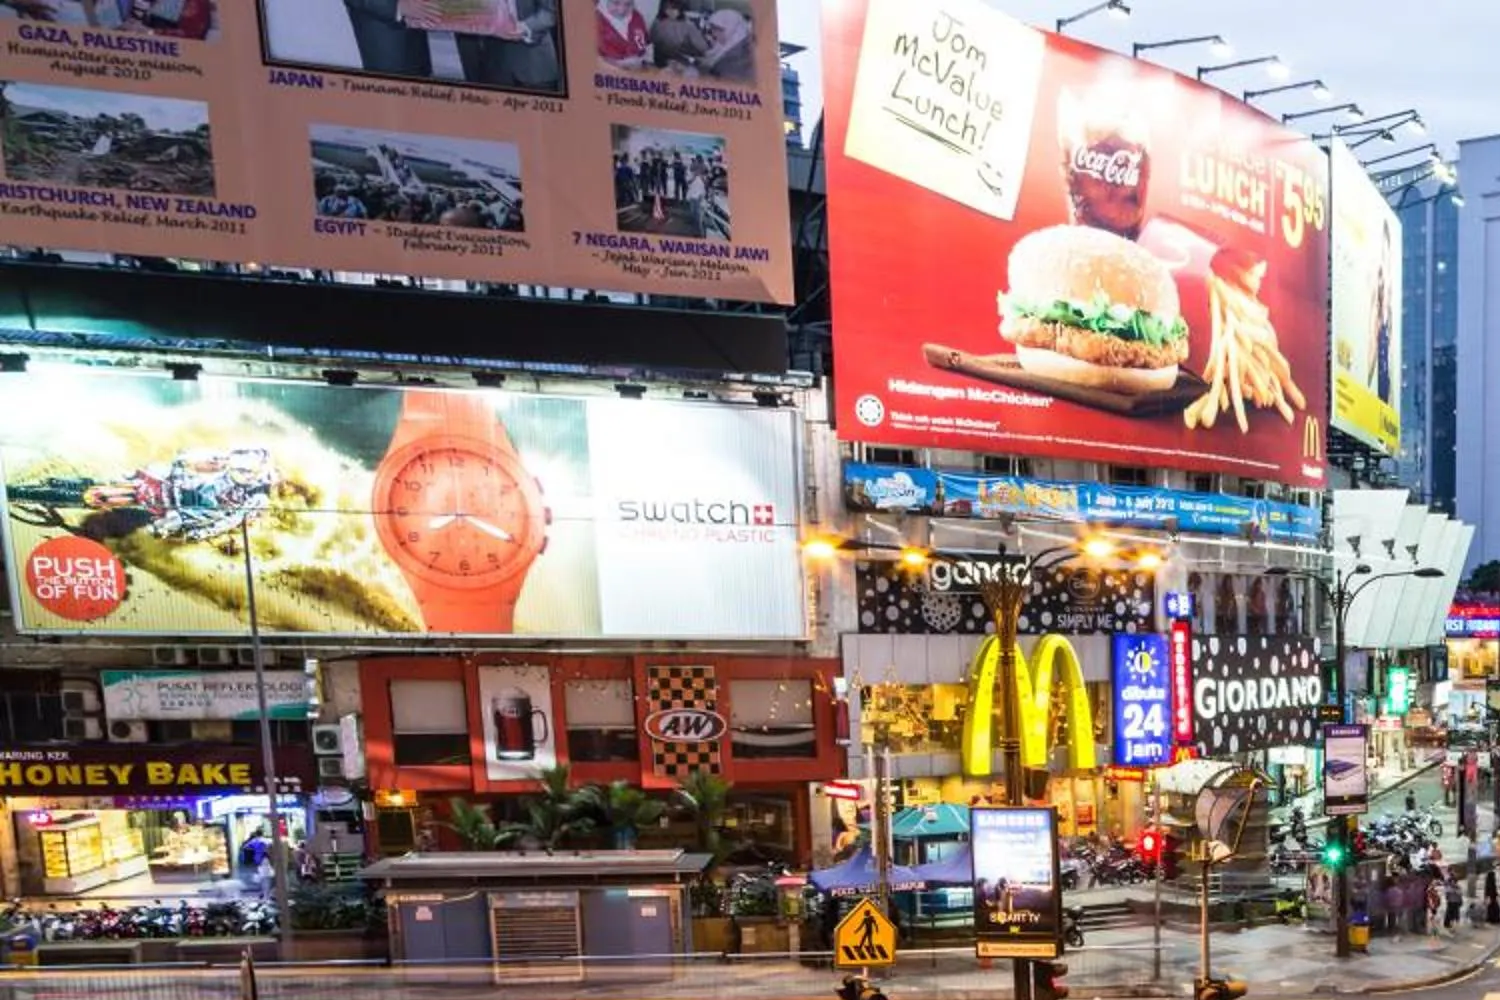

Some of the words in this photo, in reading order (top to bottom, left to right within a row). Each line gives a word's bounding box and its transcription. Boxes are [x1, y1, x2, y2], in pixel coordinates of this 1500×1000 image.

[19, 24, 77, 47] GAZA,
[83, 31, 180, 57] PALESTINE
[932, 10, 987, 71] Jom
[7, 42, 135, 67] Humanitarian
[50, 60, 108, 78] August
[113, 66, 151, 81] 2010
[893, 33, 1003, 121] McValue
[269, 70, 323, 90] JAPAN
[532, 98, 564, 114] 2011
[594, 73, 676, 98] BRISBANE,
[679, 84, 763, 107] AUSTRALIA
[723, 106, 753, 120] 2011
[891, 69, 992, 150] Lunch!
[1180, 151, 1266, 218] LUNCH
[126, 194, 169, 212] NEW
[175, 199, 258, 220] ZEALAND
[156, 215, 208, 230] March
[211, 220, 247, 235] 2011
[313, 218, 367, 237] EGYPT
[571, 231, 581, 245] 7
[586, 233, 656, 254] NEGARA,
[658, 239, 731, 258] WARISAN
[734, 246, 770, 261] JAWI
[619, 498, 749, 525] swatch
[33, 557, 116, 577] PUSH
[37, 584, 67, 600] OF
[74, 585, 118, 600] FUN
[1194, 676, 1322, 719] GIORDANO
[1123, 703, 1165, 739] 24
[1125, 741, 1163, 763] jam
[0, 762, 134, 786] HONEY
[146, 761, 252, 786] BAKE
